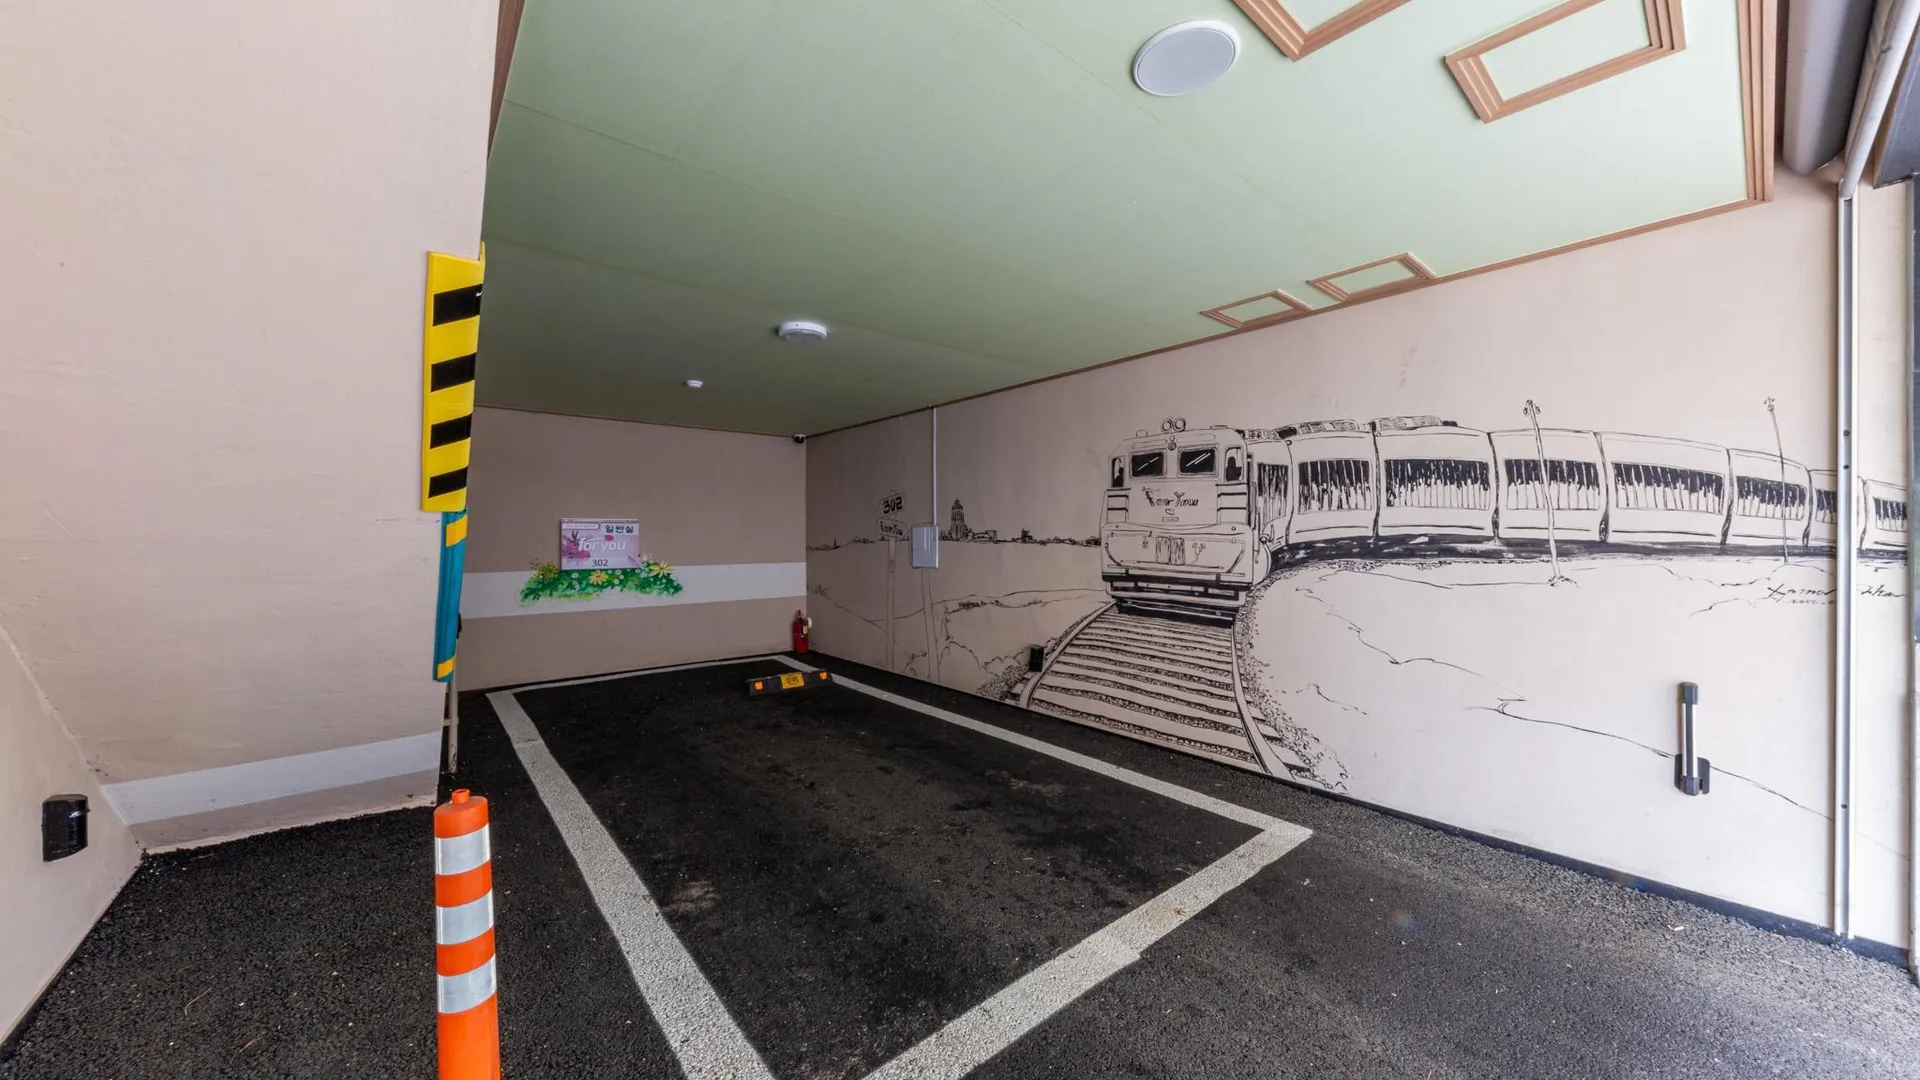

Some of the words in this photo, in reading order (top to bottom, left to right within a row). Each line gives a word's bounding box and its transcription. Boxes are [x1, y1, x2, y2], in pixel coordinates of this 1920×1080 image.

[882, 496, 903, 514] 302
[578, 537, 599, 551] for
[599, 541, 626, 553] you
[592, 559, 609, 567] 302
